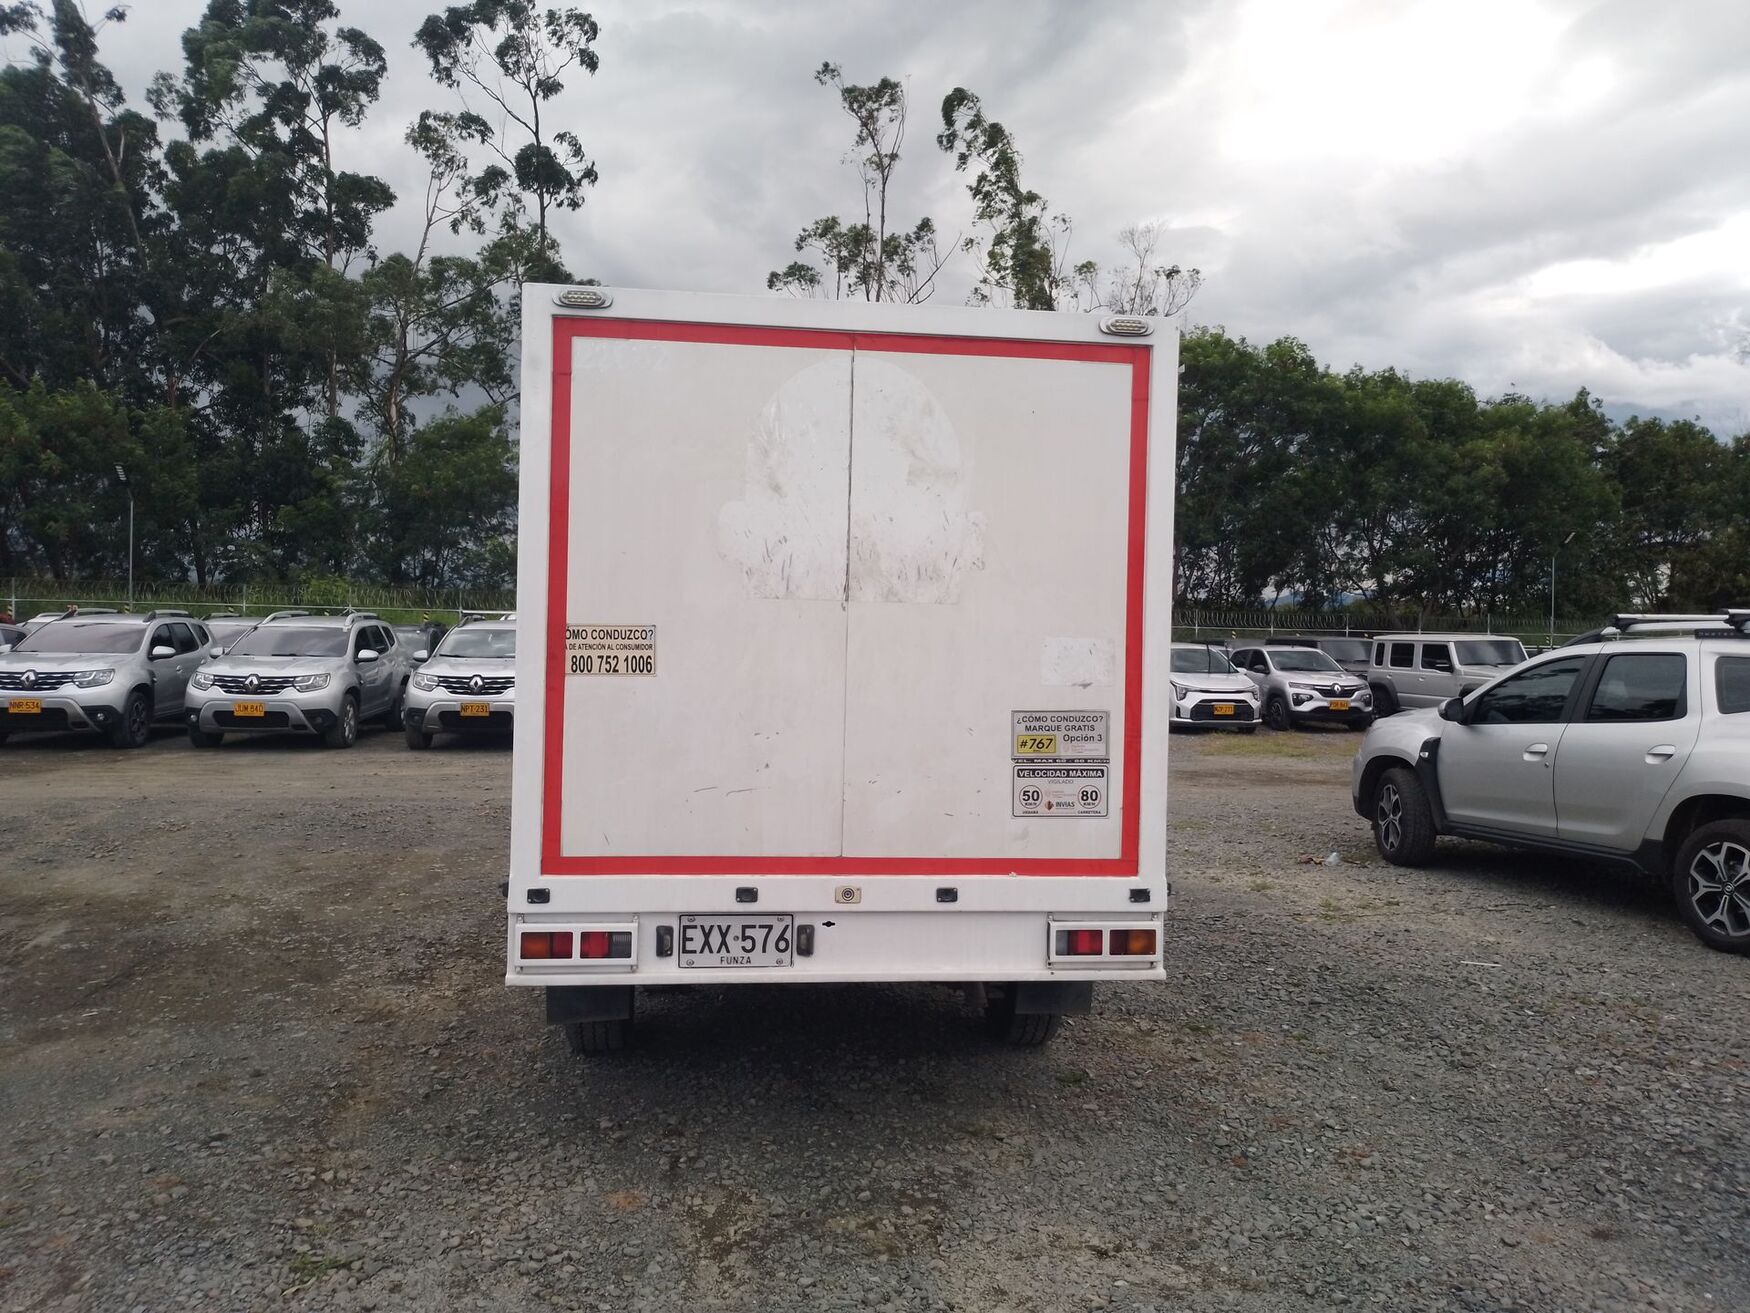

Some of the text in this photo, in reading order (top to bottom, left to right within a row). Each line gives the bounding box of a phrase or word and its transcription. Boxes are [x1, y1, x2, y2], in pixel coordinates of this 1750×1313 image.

[591, 629, 654, 640] CONDUZCO?
[578, 643, 606, 651] ATENCIÓN
[571, 655, 653, 673] 800 752 1006
[1050, 715, 1103, 723] CONDUZCO?
[1025, 724, 1095, 732] MARQUE GRATIS
[1063, 734, 1103, 743] Opción 3
[1020, 738, 1053, 750] #767
[1022, 790, 1040, 801] 50
[1081, 790, 1099, 801] 80
[720, 956, 752, 965] FUNZA
